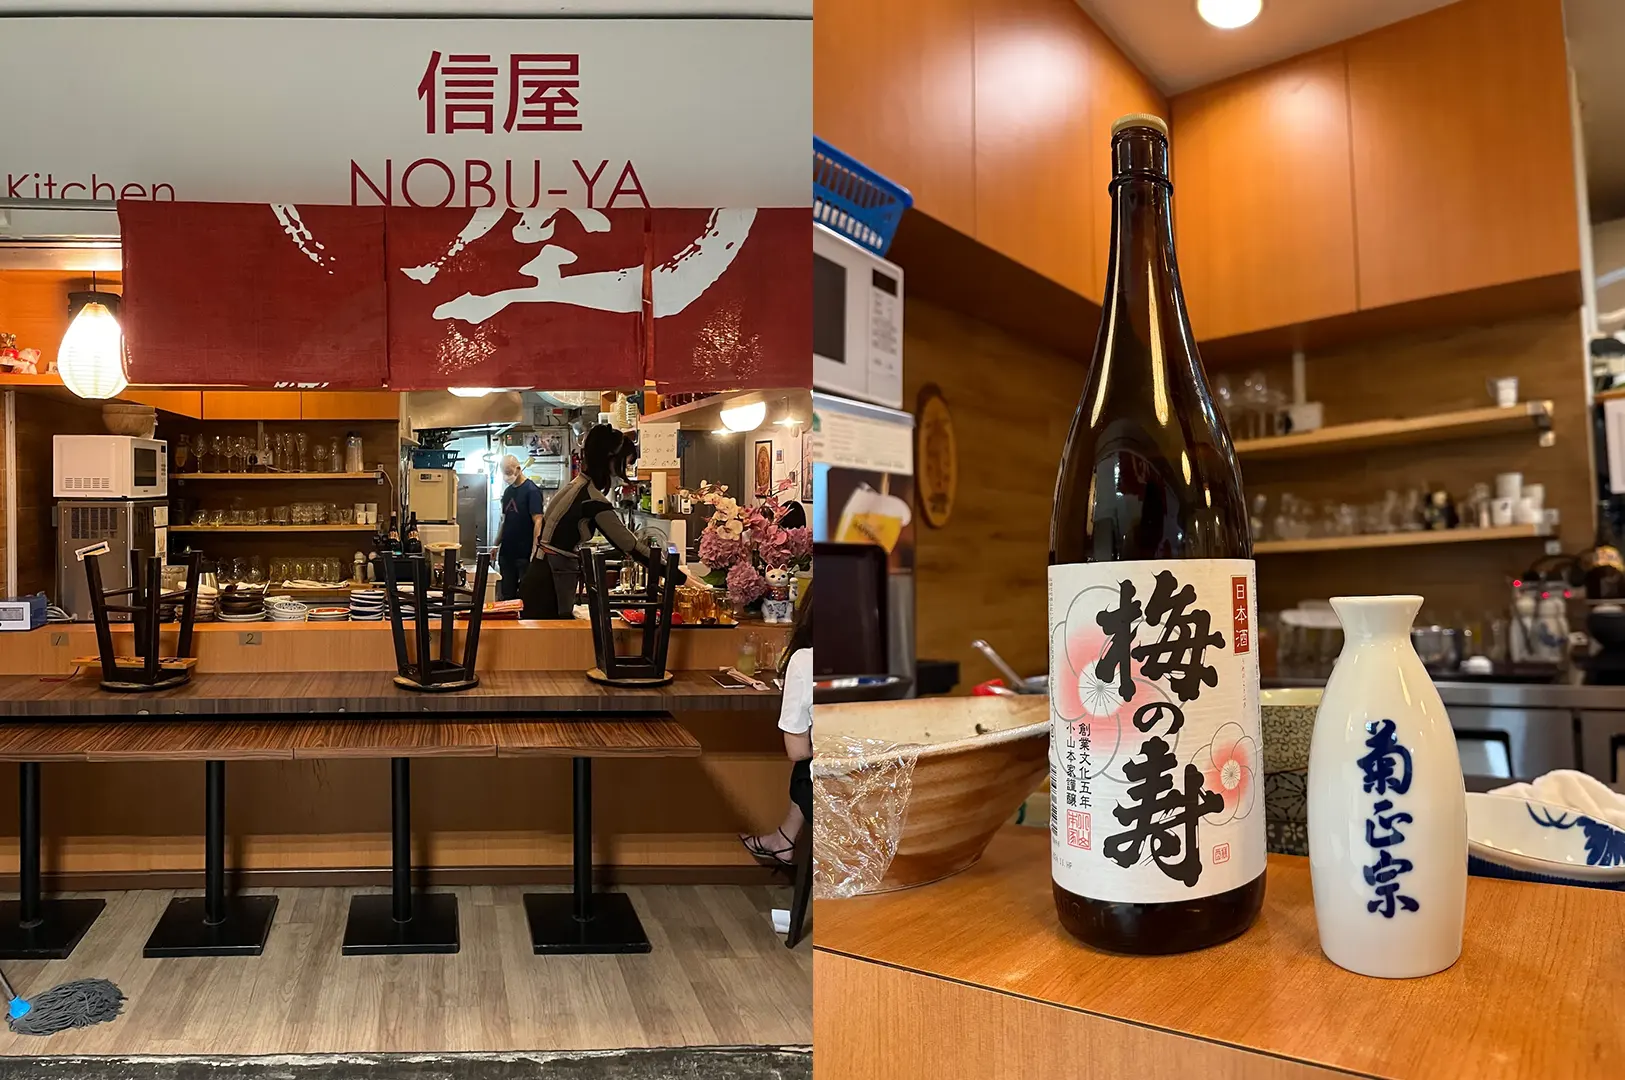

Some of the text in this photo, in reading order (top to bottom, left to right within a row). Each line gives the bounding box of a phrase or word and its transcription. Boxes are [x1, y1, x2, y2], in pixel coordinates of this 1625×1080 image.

[418, 51, 582, 134] 信屋
[8, 173, 175, 201] Kitchen
[350, 158, 650, 208] NOBU-YA
[245, 633, 254, 645] 2
[1235, 584, 1249, 648] 日本酒
[1095, 569, 1226, 888] 梅の寿
[1078, 722, 1093, 809] 創業文化五年
[1356, 718, 1420, 919] 菊正宗
